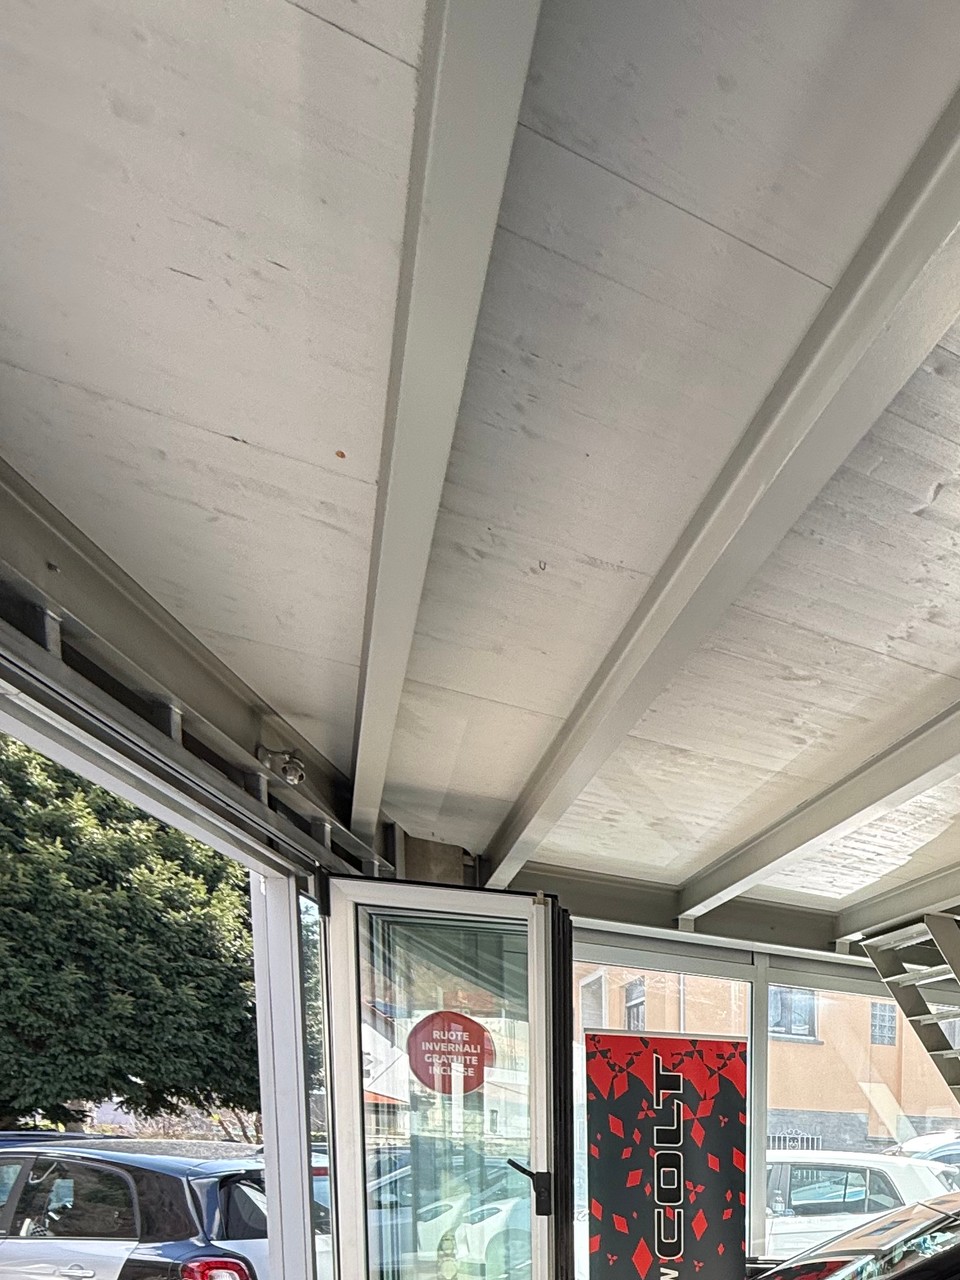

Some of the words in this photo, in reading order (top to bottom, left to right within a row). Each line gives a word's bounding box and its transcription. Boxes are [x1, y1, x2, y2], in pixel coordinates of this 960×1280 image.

[432, 1030, 470, 1041] RUOTE
[421, 1041, 481, 1053] INVERNALI
[424, 1053, 479, 1065] GRATUITE
[428, 1065, 475, 1077] INCLSE
[653, 1053, 684, 1260] COLT
